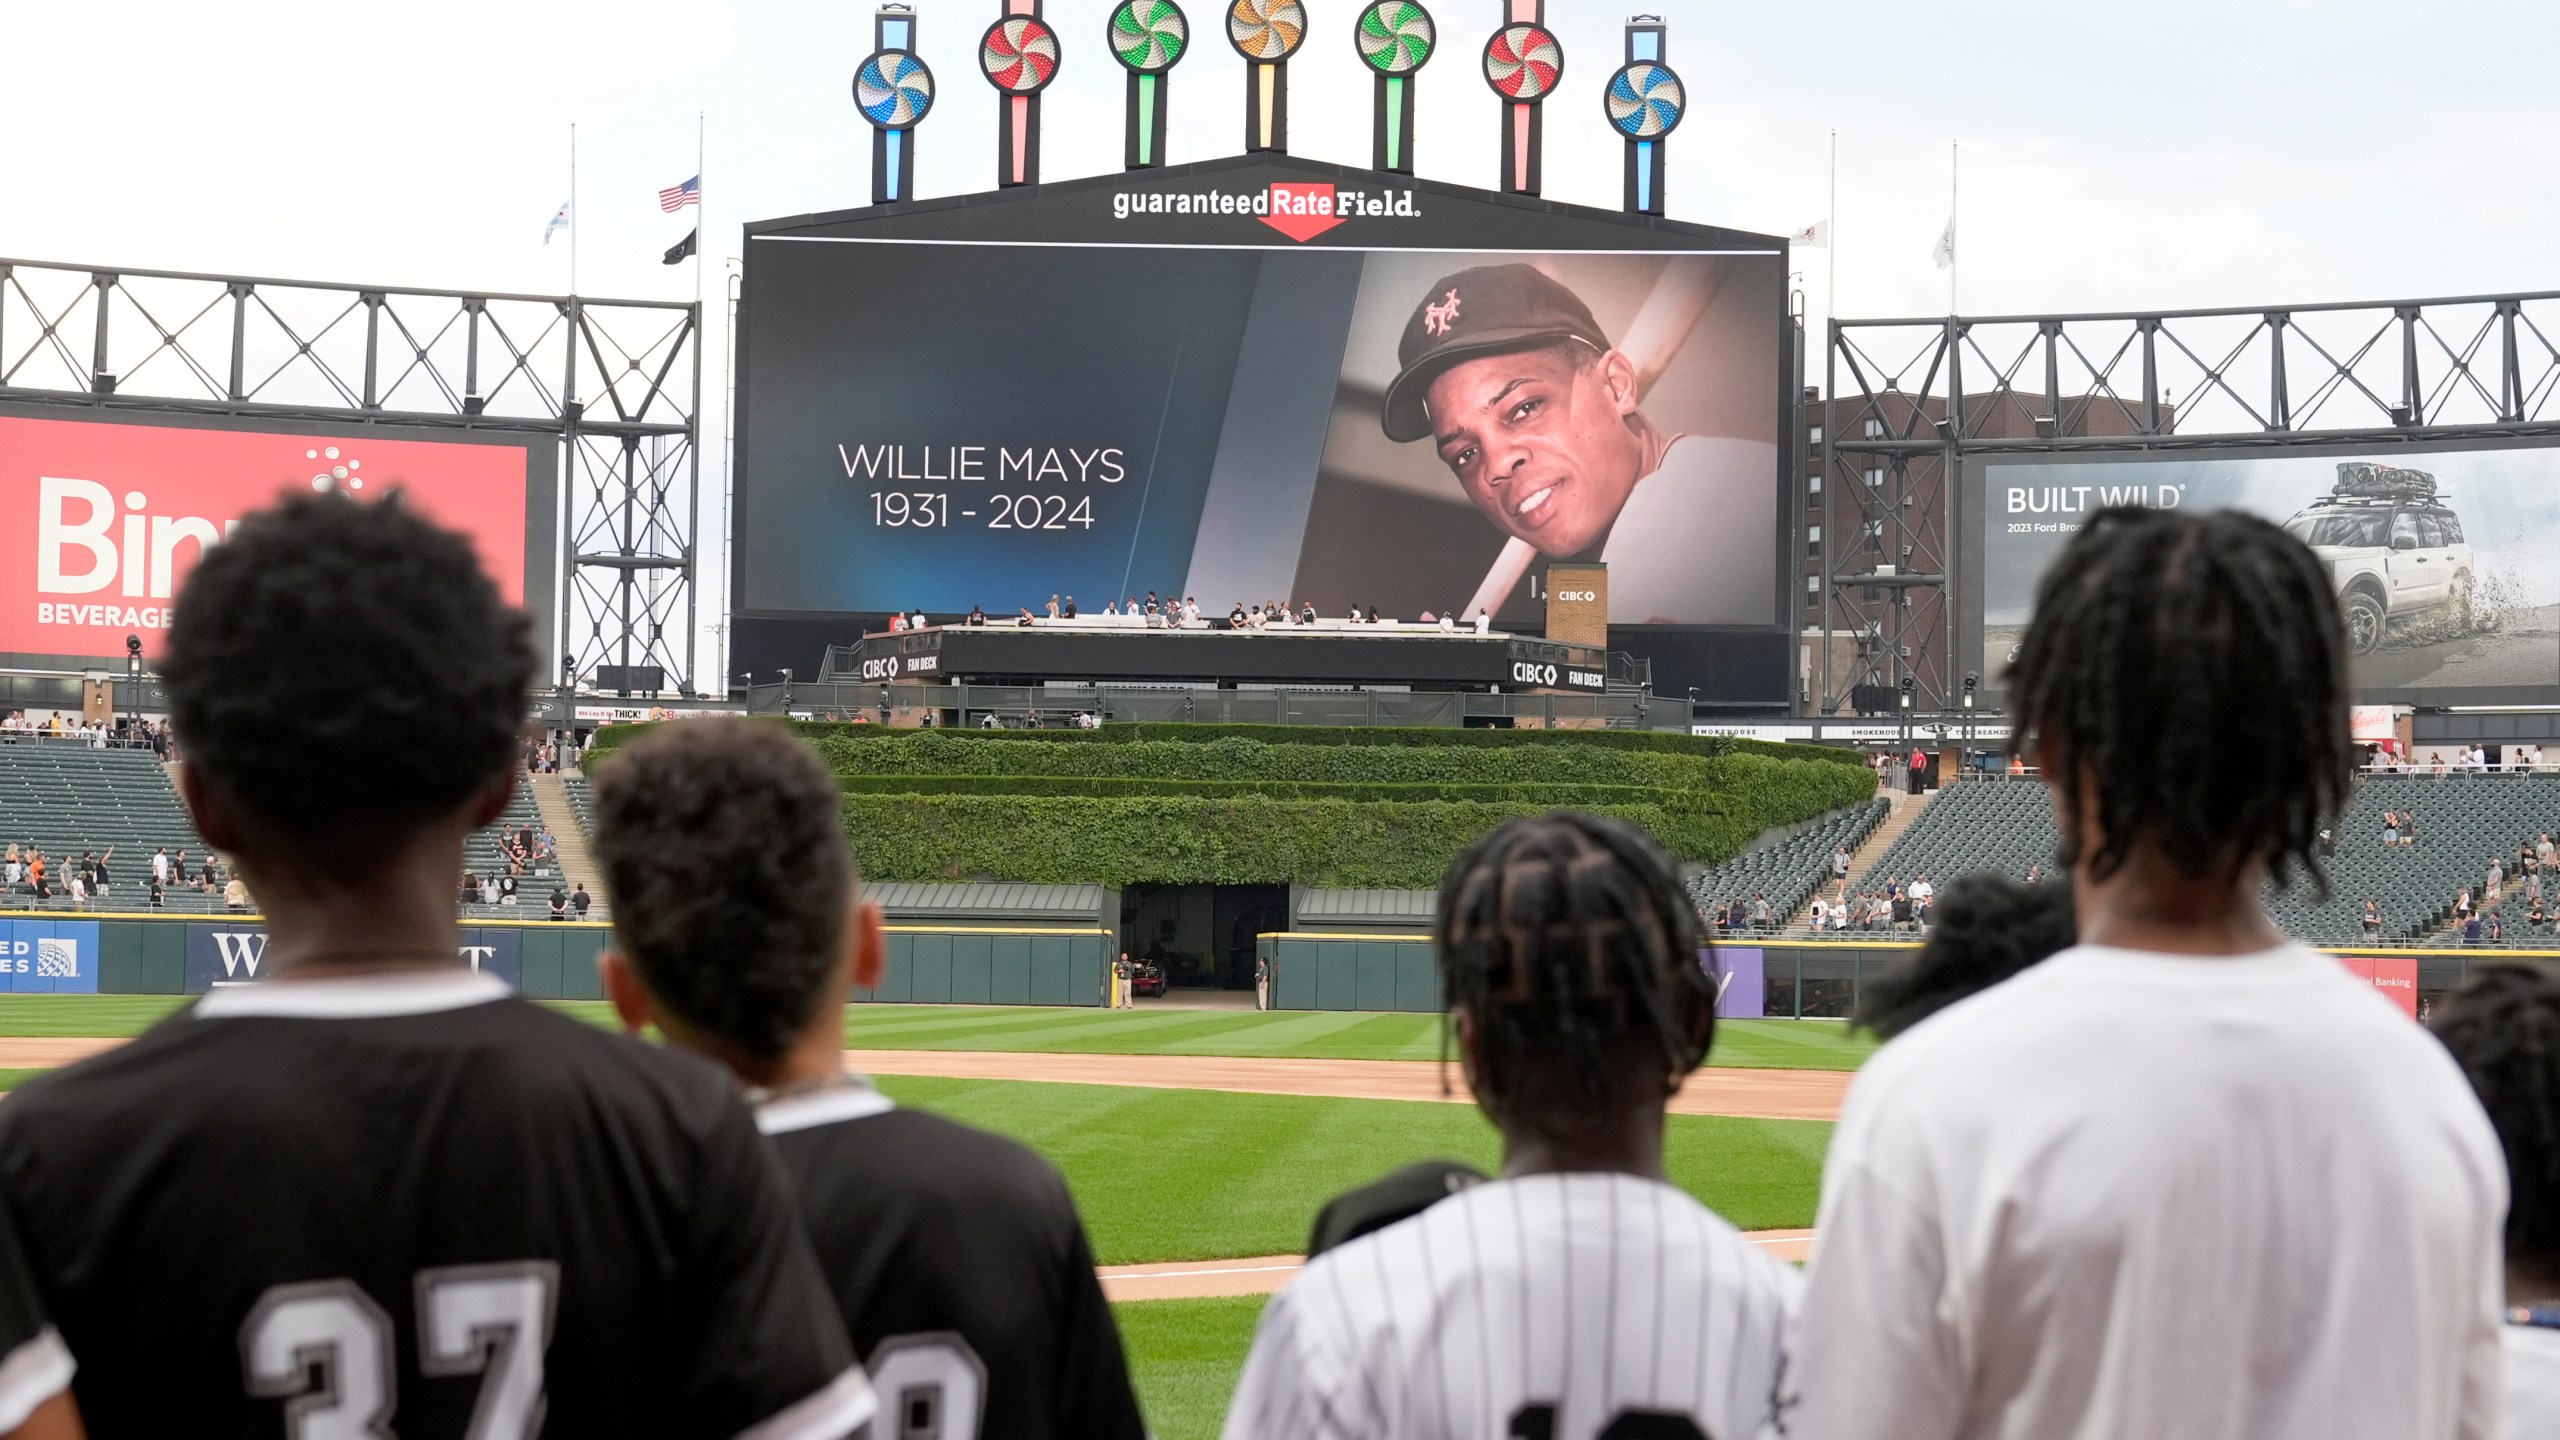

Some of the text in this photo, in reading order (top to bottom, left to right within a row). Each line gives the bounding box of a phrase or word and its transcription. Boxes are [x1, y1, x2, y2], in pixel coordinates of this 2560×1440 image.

[1113, 189, 1268, 219] guaranteed
[1273, 189, 1332, 216] Rate
[838, 444, 1125, 483] WILLIE MAYS
[869, 491, 947, 528] 1931
[987, 494, 1095, 530] 2024
[2007, 486, 2092, 513] BUILT
[2007, 522, 2032, 533] 2023
[2035, 522, 2057, 533] Ford
[1558, 591, 1584, 601] CIBC
[863, 656, 938, 680] CIBC FAN DECK
[1513, 662, 1603, 688] CIBC FAN DECK
[614, 709, 641, 719] THICK!
[2375, 977, 2411, 988] Banking
